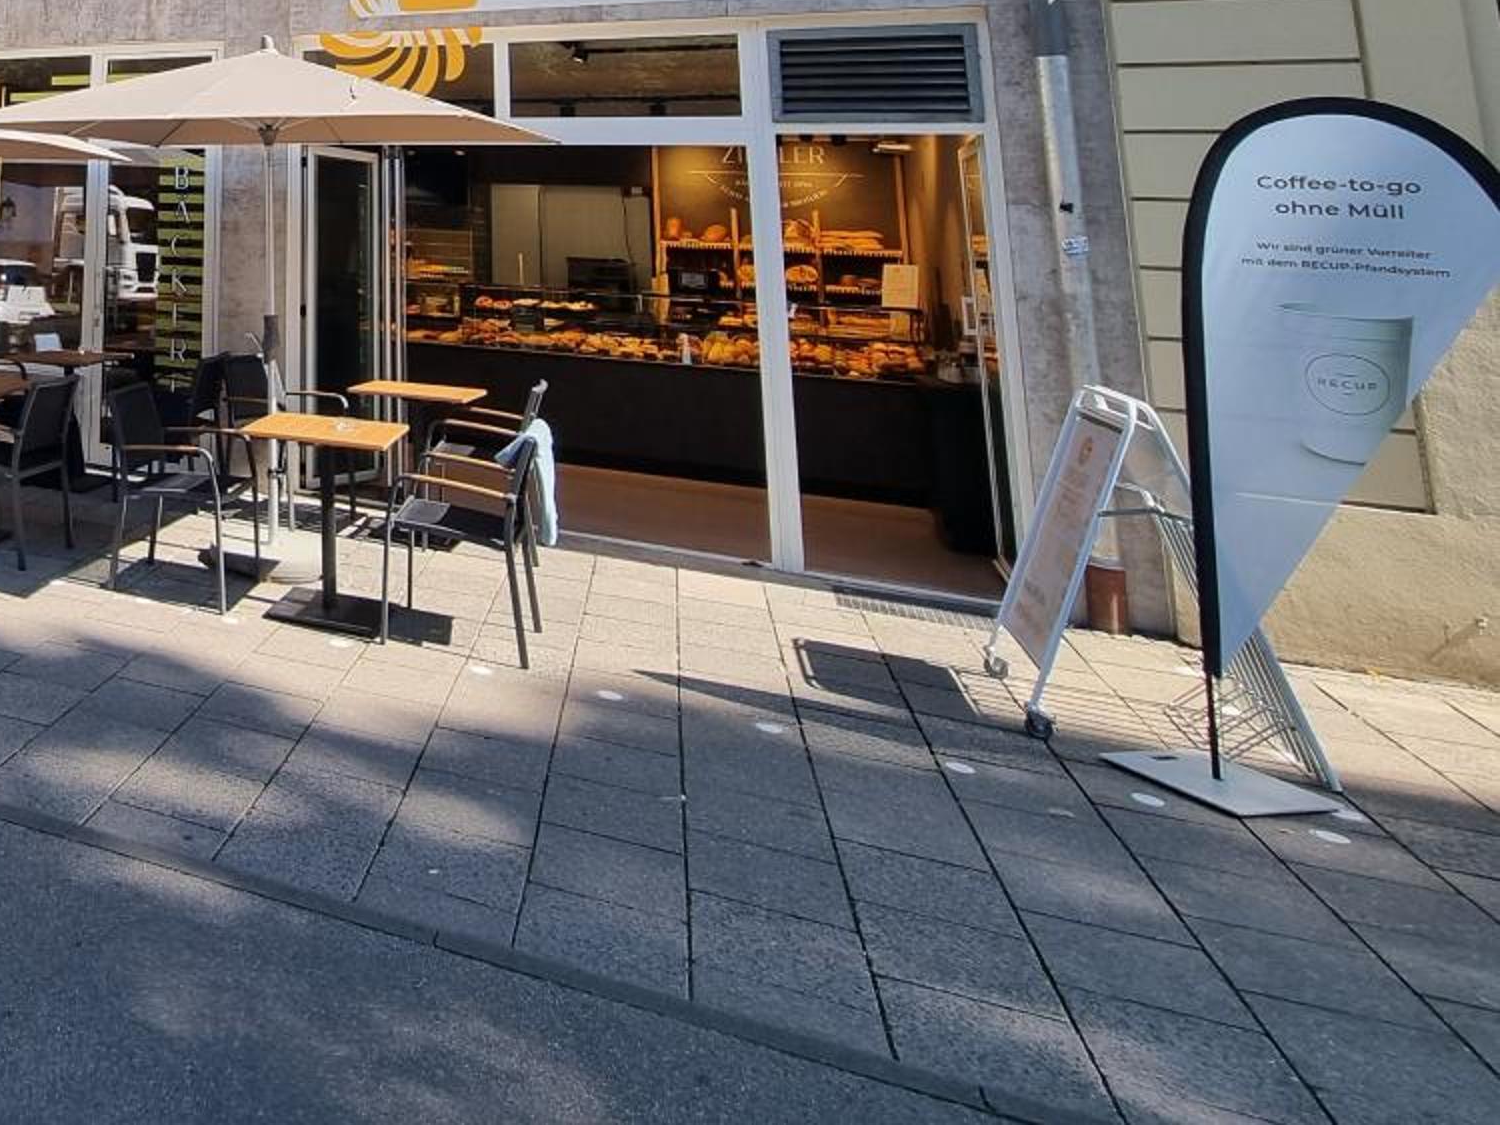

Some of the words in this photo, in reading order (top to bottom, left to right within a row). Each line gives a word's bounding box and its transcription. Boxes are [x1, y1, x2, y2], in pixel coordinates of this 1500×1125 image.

[722, 145, 825, 165] ZILER
[1256, 175, 1422, 196] Coffee-to-go
[1275, 200, 1340, 217] ohne
[1348, 203, 1405, 220] Müll
[1256, 241, 1280, 251] Wir
[1283, 244, 1313, 253] sind
[1315, 245, 1364, 256] grüner
[1241, 256, 1264, 266] mit
[1267, 258, 1298, 268] dem
